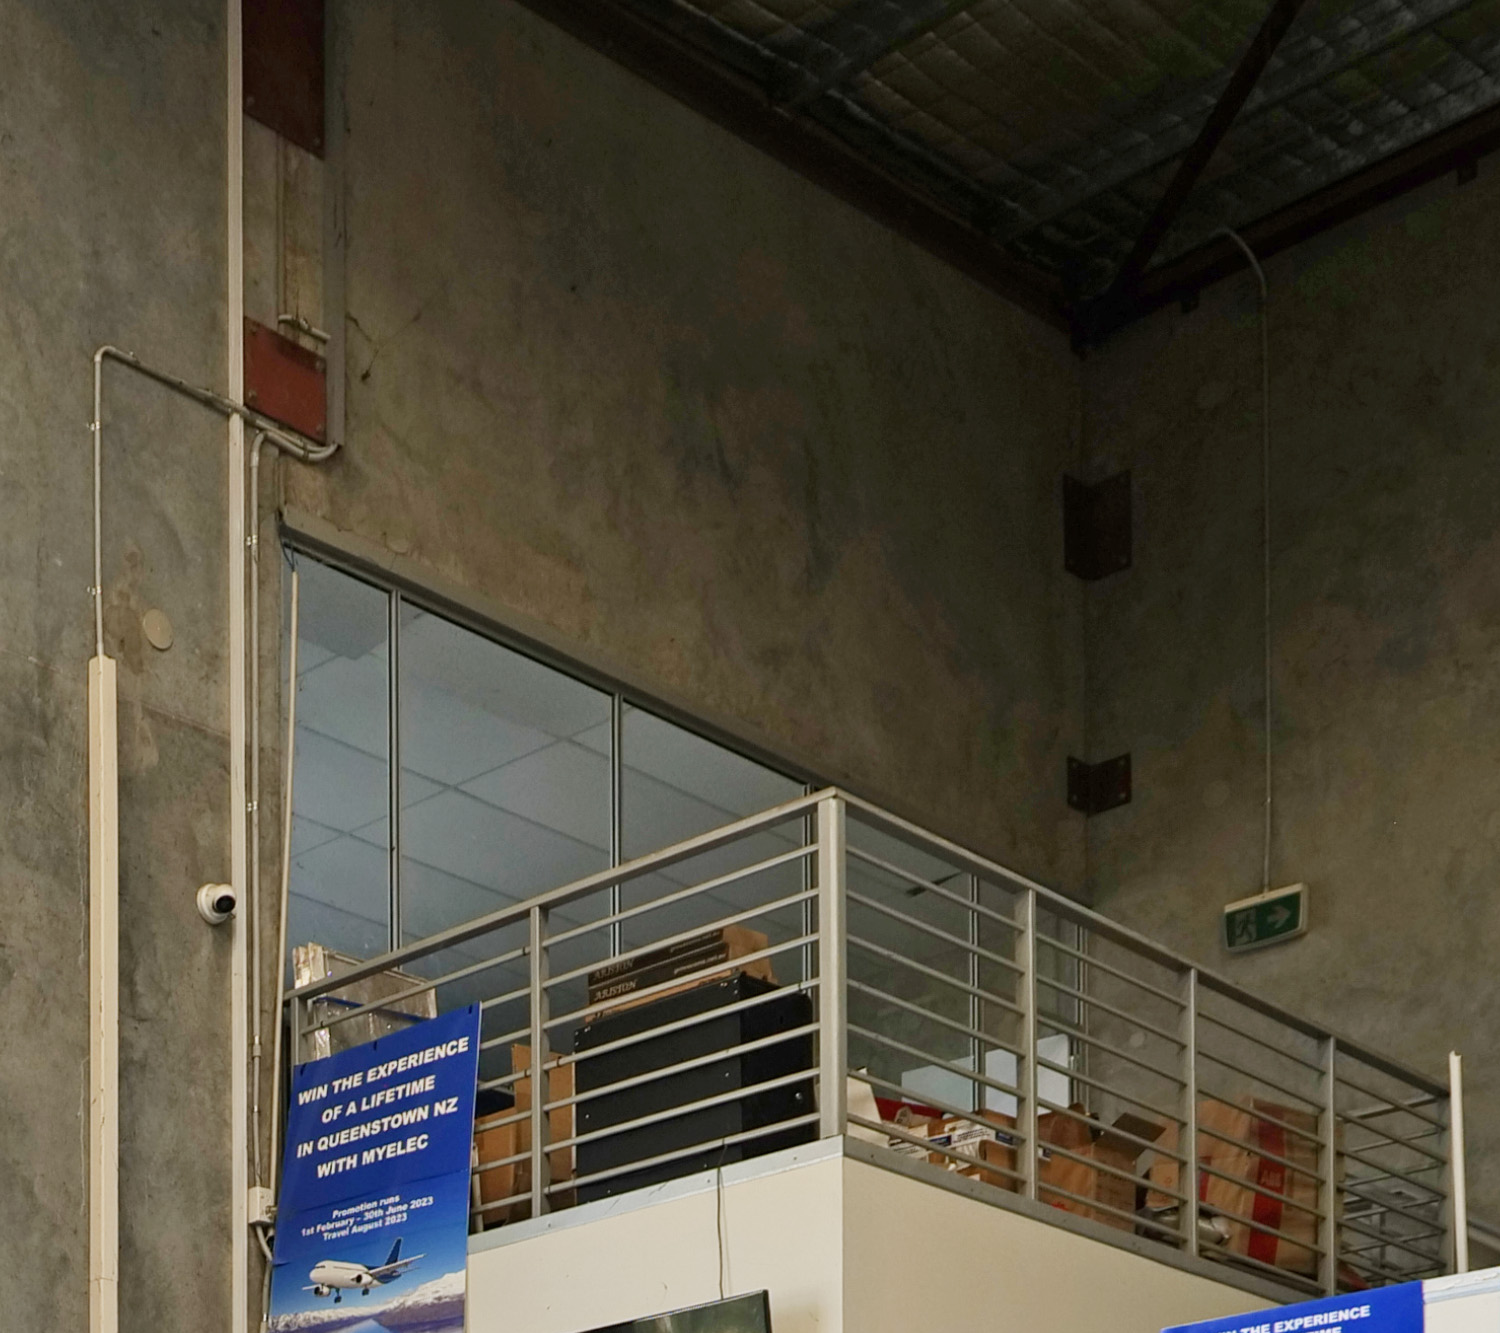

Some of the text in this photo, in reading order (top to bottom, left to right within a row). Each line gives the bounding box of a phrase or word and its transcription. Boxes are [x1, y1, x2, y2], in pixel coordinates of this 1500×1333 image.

[298, 1037, 468, 1105] WIN THE EXPERIENCE
[322, 1075, 435, 1124] OF A LIFETIME
[297, 1097, 458, 1158] IN QUEENSTOWN NZ
[317, 1134, 429, 1178] WITH MYELEC
[302, 1196, 433, 1237] 1st February 30th June 2023
[323, 1213, 407, 1241] Travel August 2023
[332, 1195, 400, 1219] Promotion runs
[1274, 1305, 1370, 1333] EXPERIENCE
